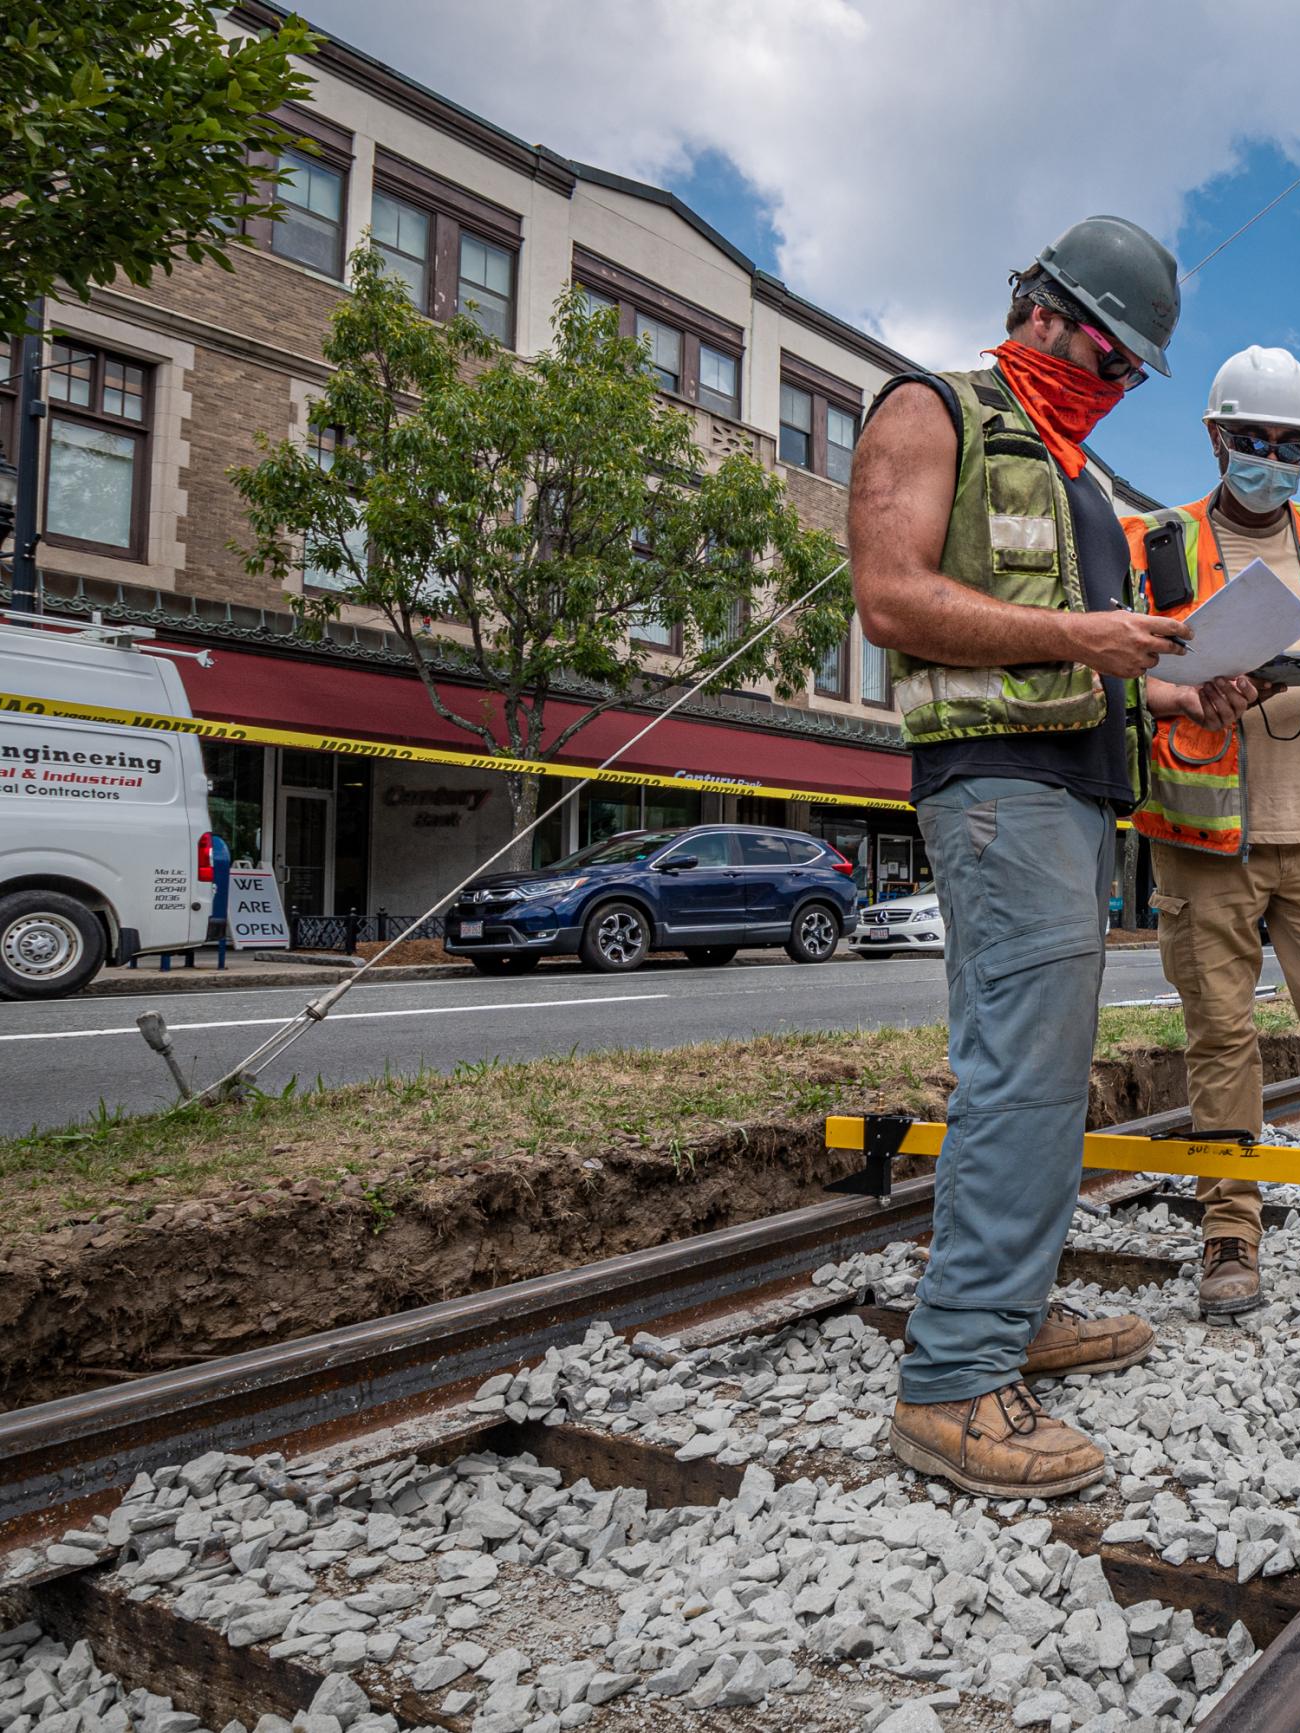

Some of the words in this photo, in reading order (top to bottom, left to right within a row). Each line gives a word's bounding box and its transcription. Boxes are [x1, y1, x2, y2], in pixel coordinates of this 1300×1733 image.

[21, 767, 37, 779] &
[42, 769, 143, 788] Industrial
[24, 783, 120, 800] Contractors
[233, 878, 265, 891] WE
[238, 901, 273, 913] ARE
[236, 923, 284, 936] OPEN
